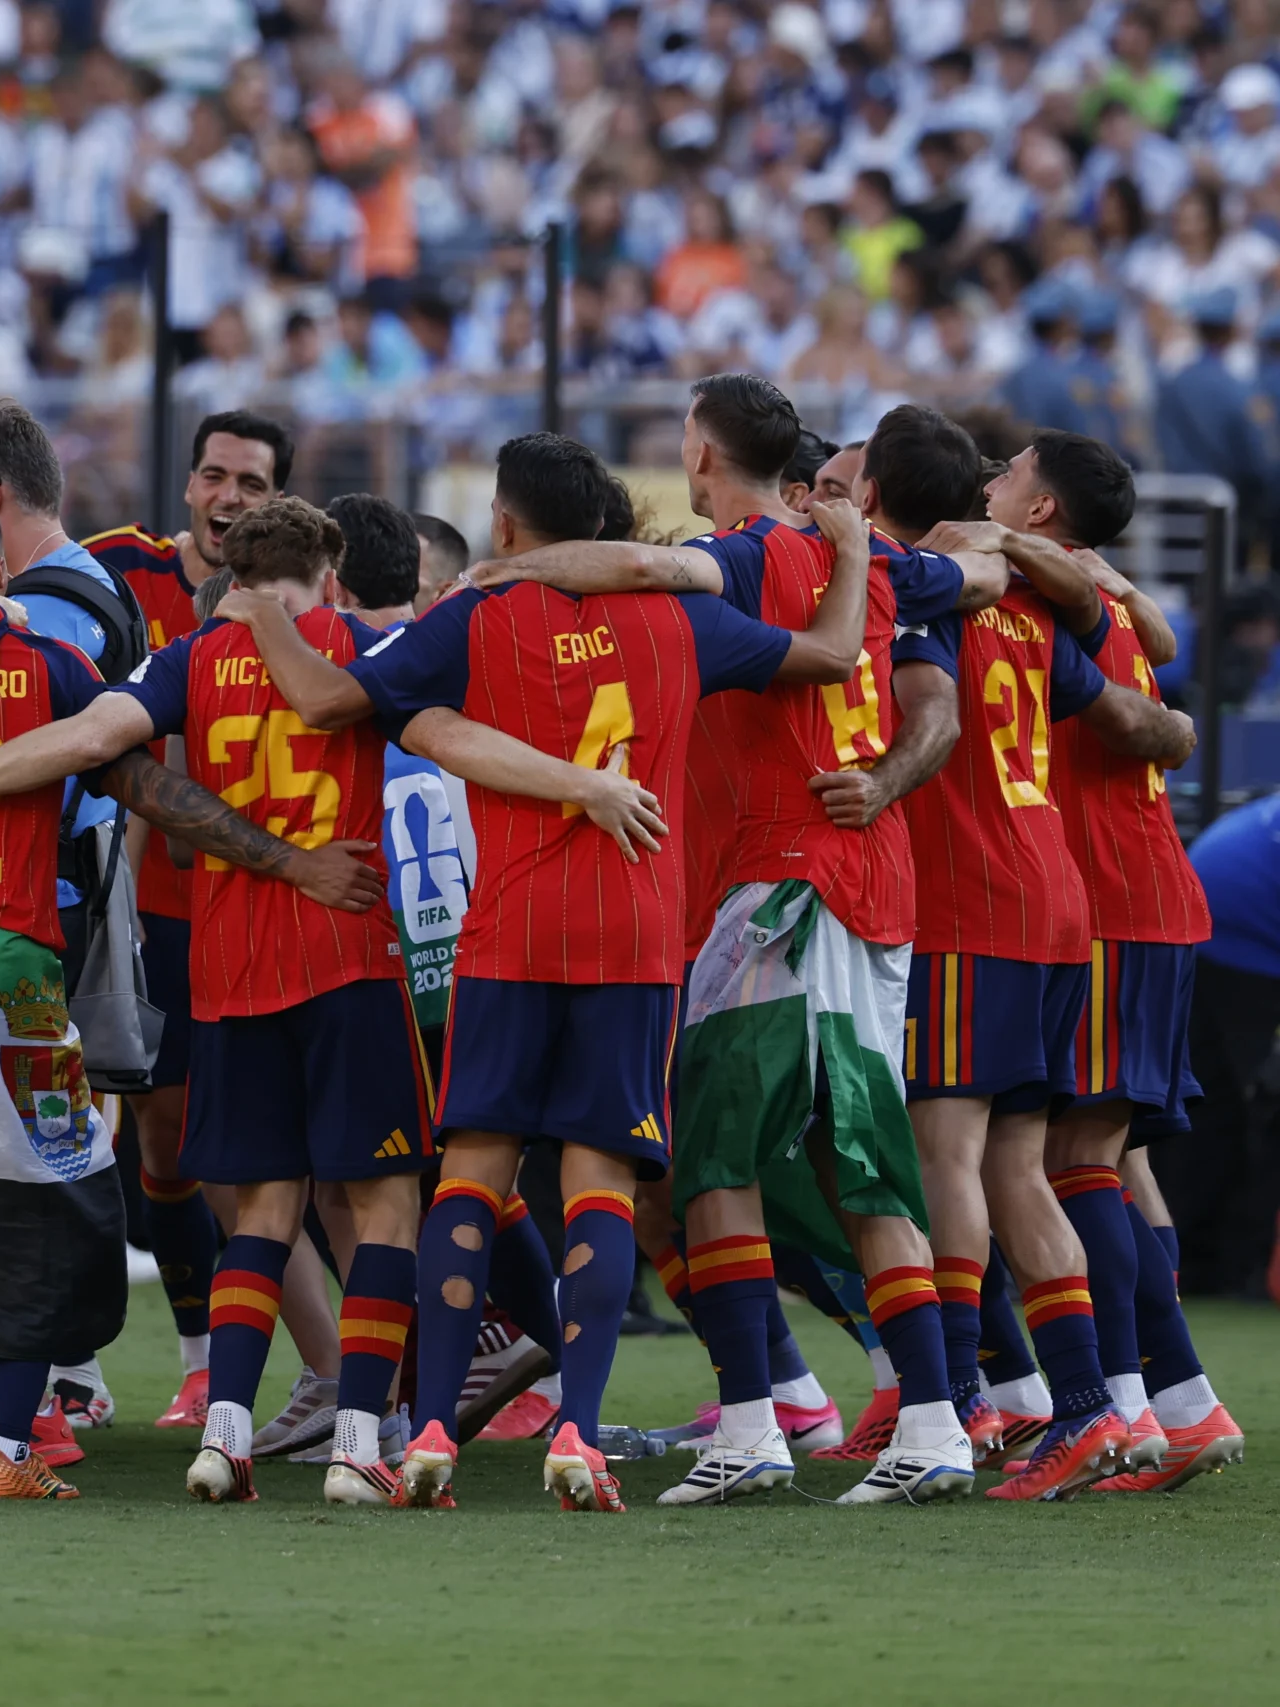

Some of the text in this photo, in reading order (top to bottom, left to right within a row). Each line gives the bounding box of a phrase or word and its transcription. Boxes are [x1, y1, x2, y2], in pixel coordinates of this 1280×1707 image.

[553, 625, 614, 664] ERIC
[562, 681, 640, 819] 4
[983, 658, 1059, 812] 21
[417, 905, 451, 927] FIFA
[410, 946, 449, 968] WORLD
[414, 962, 454, 994] 202
